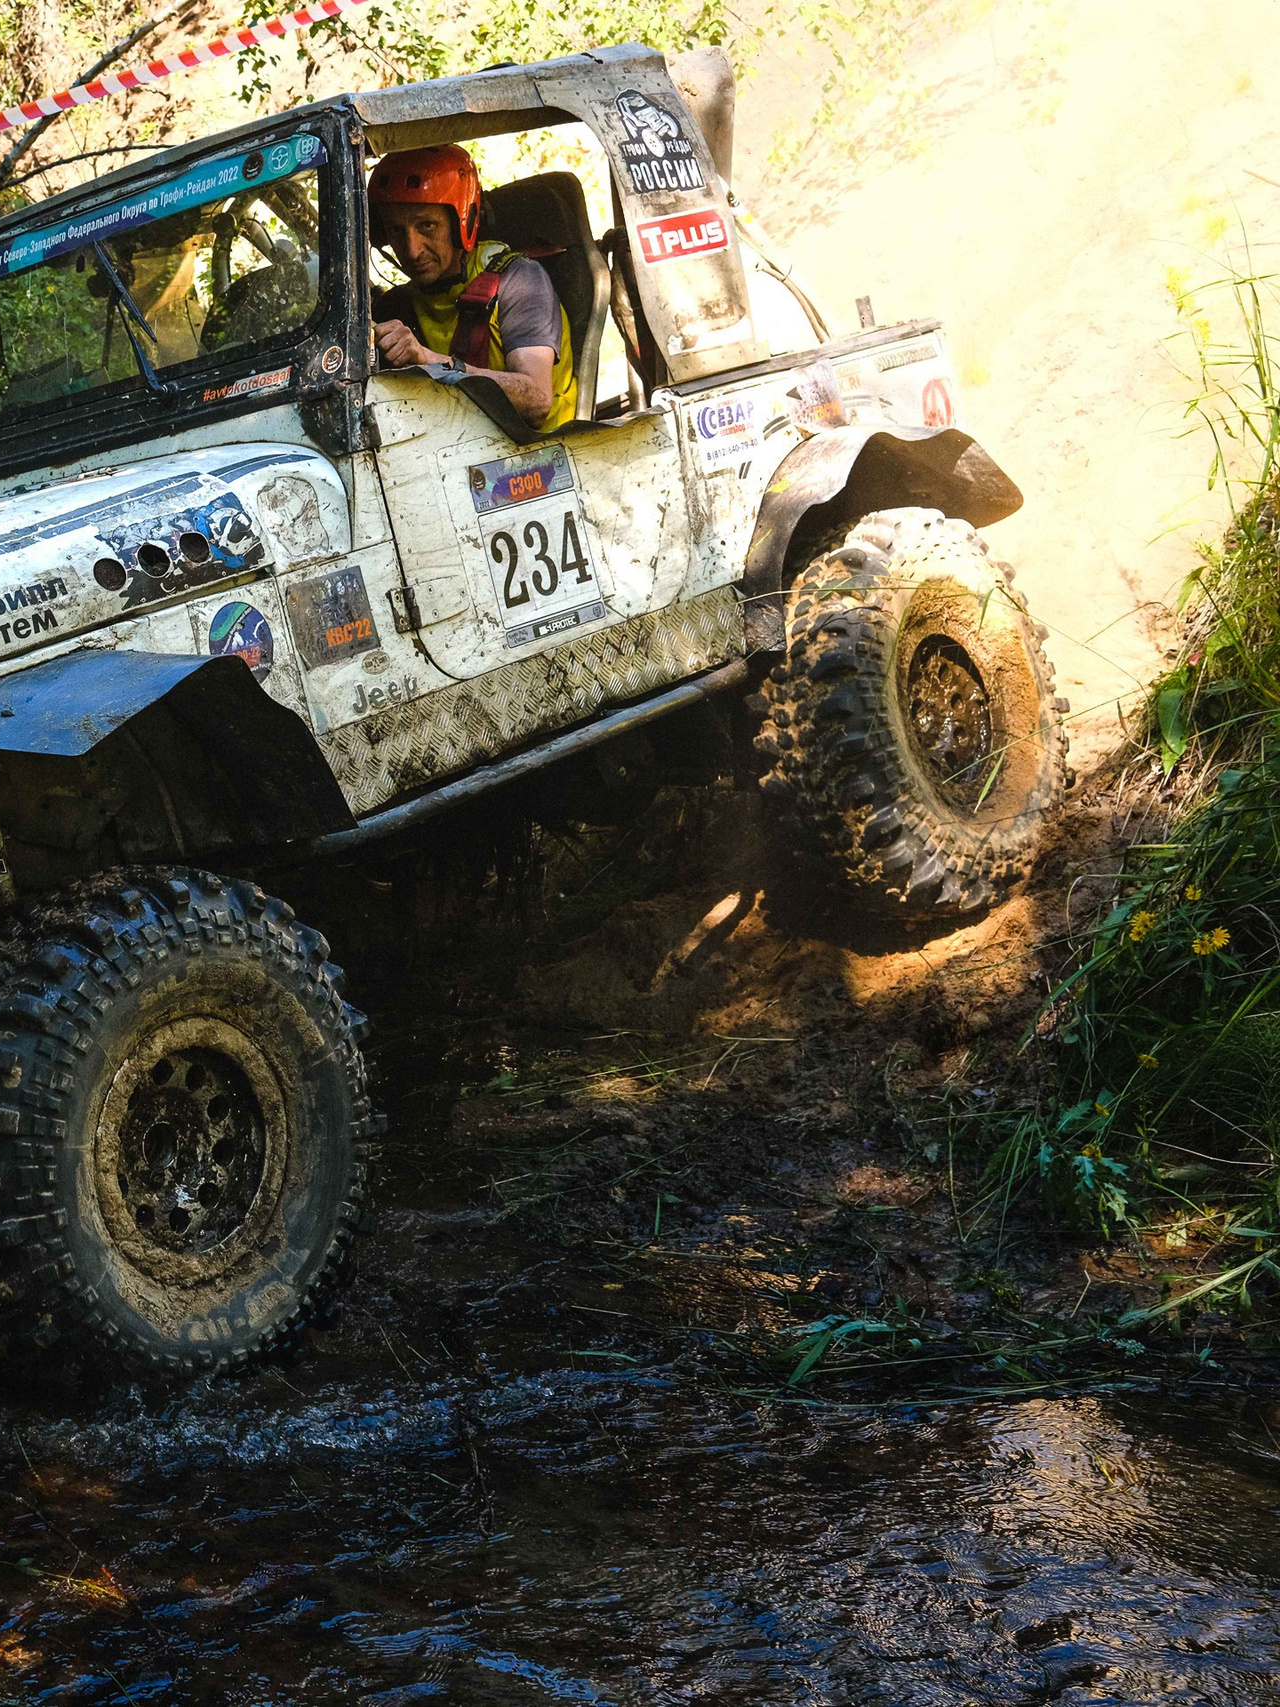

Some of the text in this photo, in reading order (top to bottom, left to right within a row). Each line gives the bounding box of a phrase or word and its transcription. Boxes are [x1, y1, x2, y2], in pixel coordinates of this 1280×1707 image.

[630, 158, 704, 191] РОССИИ
[4, 232, 66, 262] Северо-Западного
[67, 214, 120, 239] Федерального
[121, 203, 147, 220] Округа
[148, 197, 158, 208] по
[160, 177, 217, 207] Трофи-Рейдам
[218, 166, 239, 186] 2022
[641, 221, 724, 257] TPLUS
[509, 471, 543, 496] СЗФО
[491, 511, 593, 609] 234
[353, 675, 418, 714] Jeep
